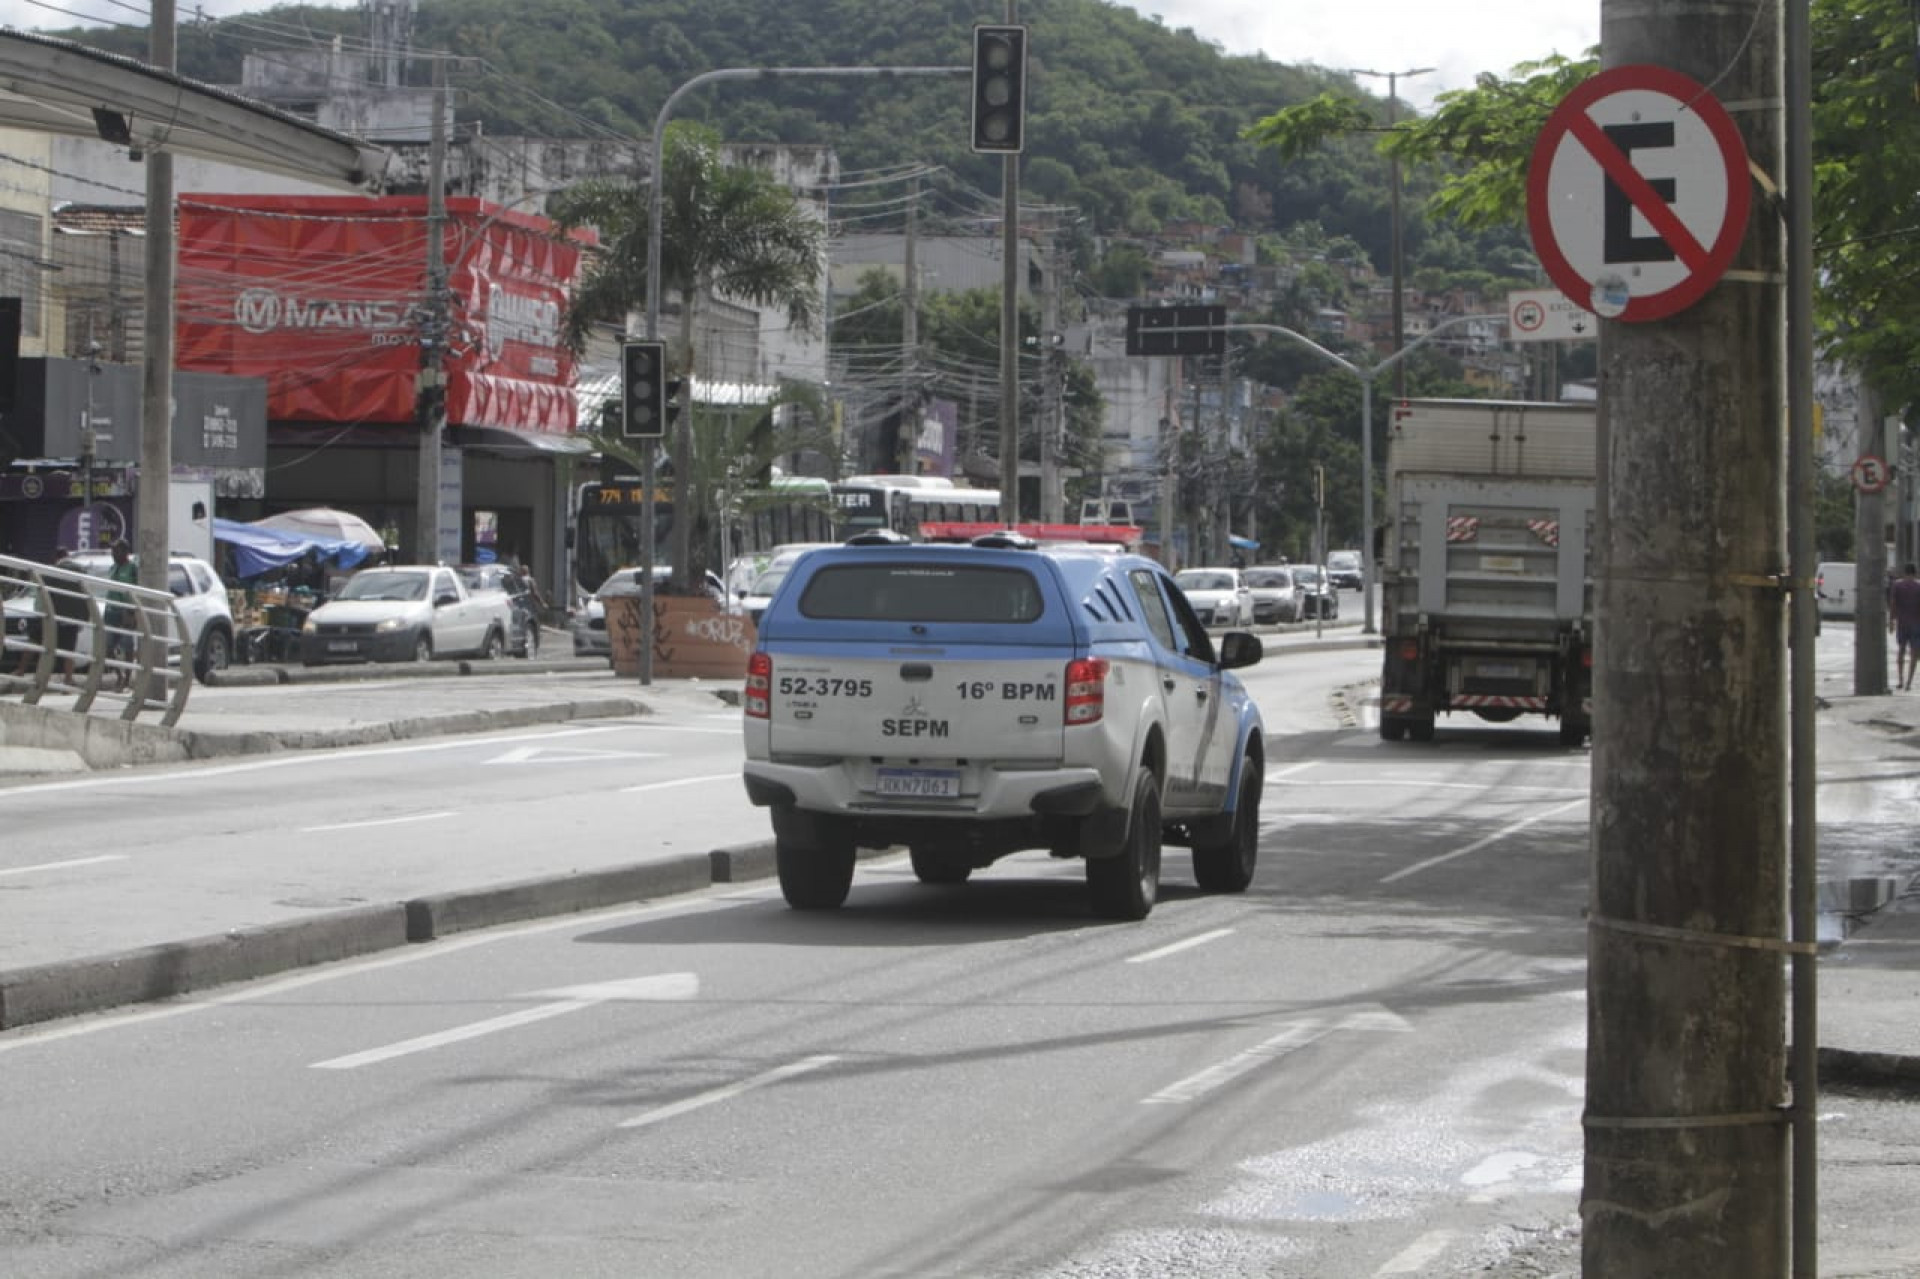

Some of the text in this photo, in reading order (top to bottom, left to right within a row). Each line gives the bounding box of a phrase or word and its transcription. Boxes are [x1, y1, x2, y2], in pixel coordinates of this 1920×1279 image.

[1603, 121, 1677, 264] E
[779, 677, 873, 698] 52-3795
[1002, 682, 1056, 702] BPM
[881, 719, 949, 738] SEPM
